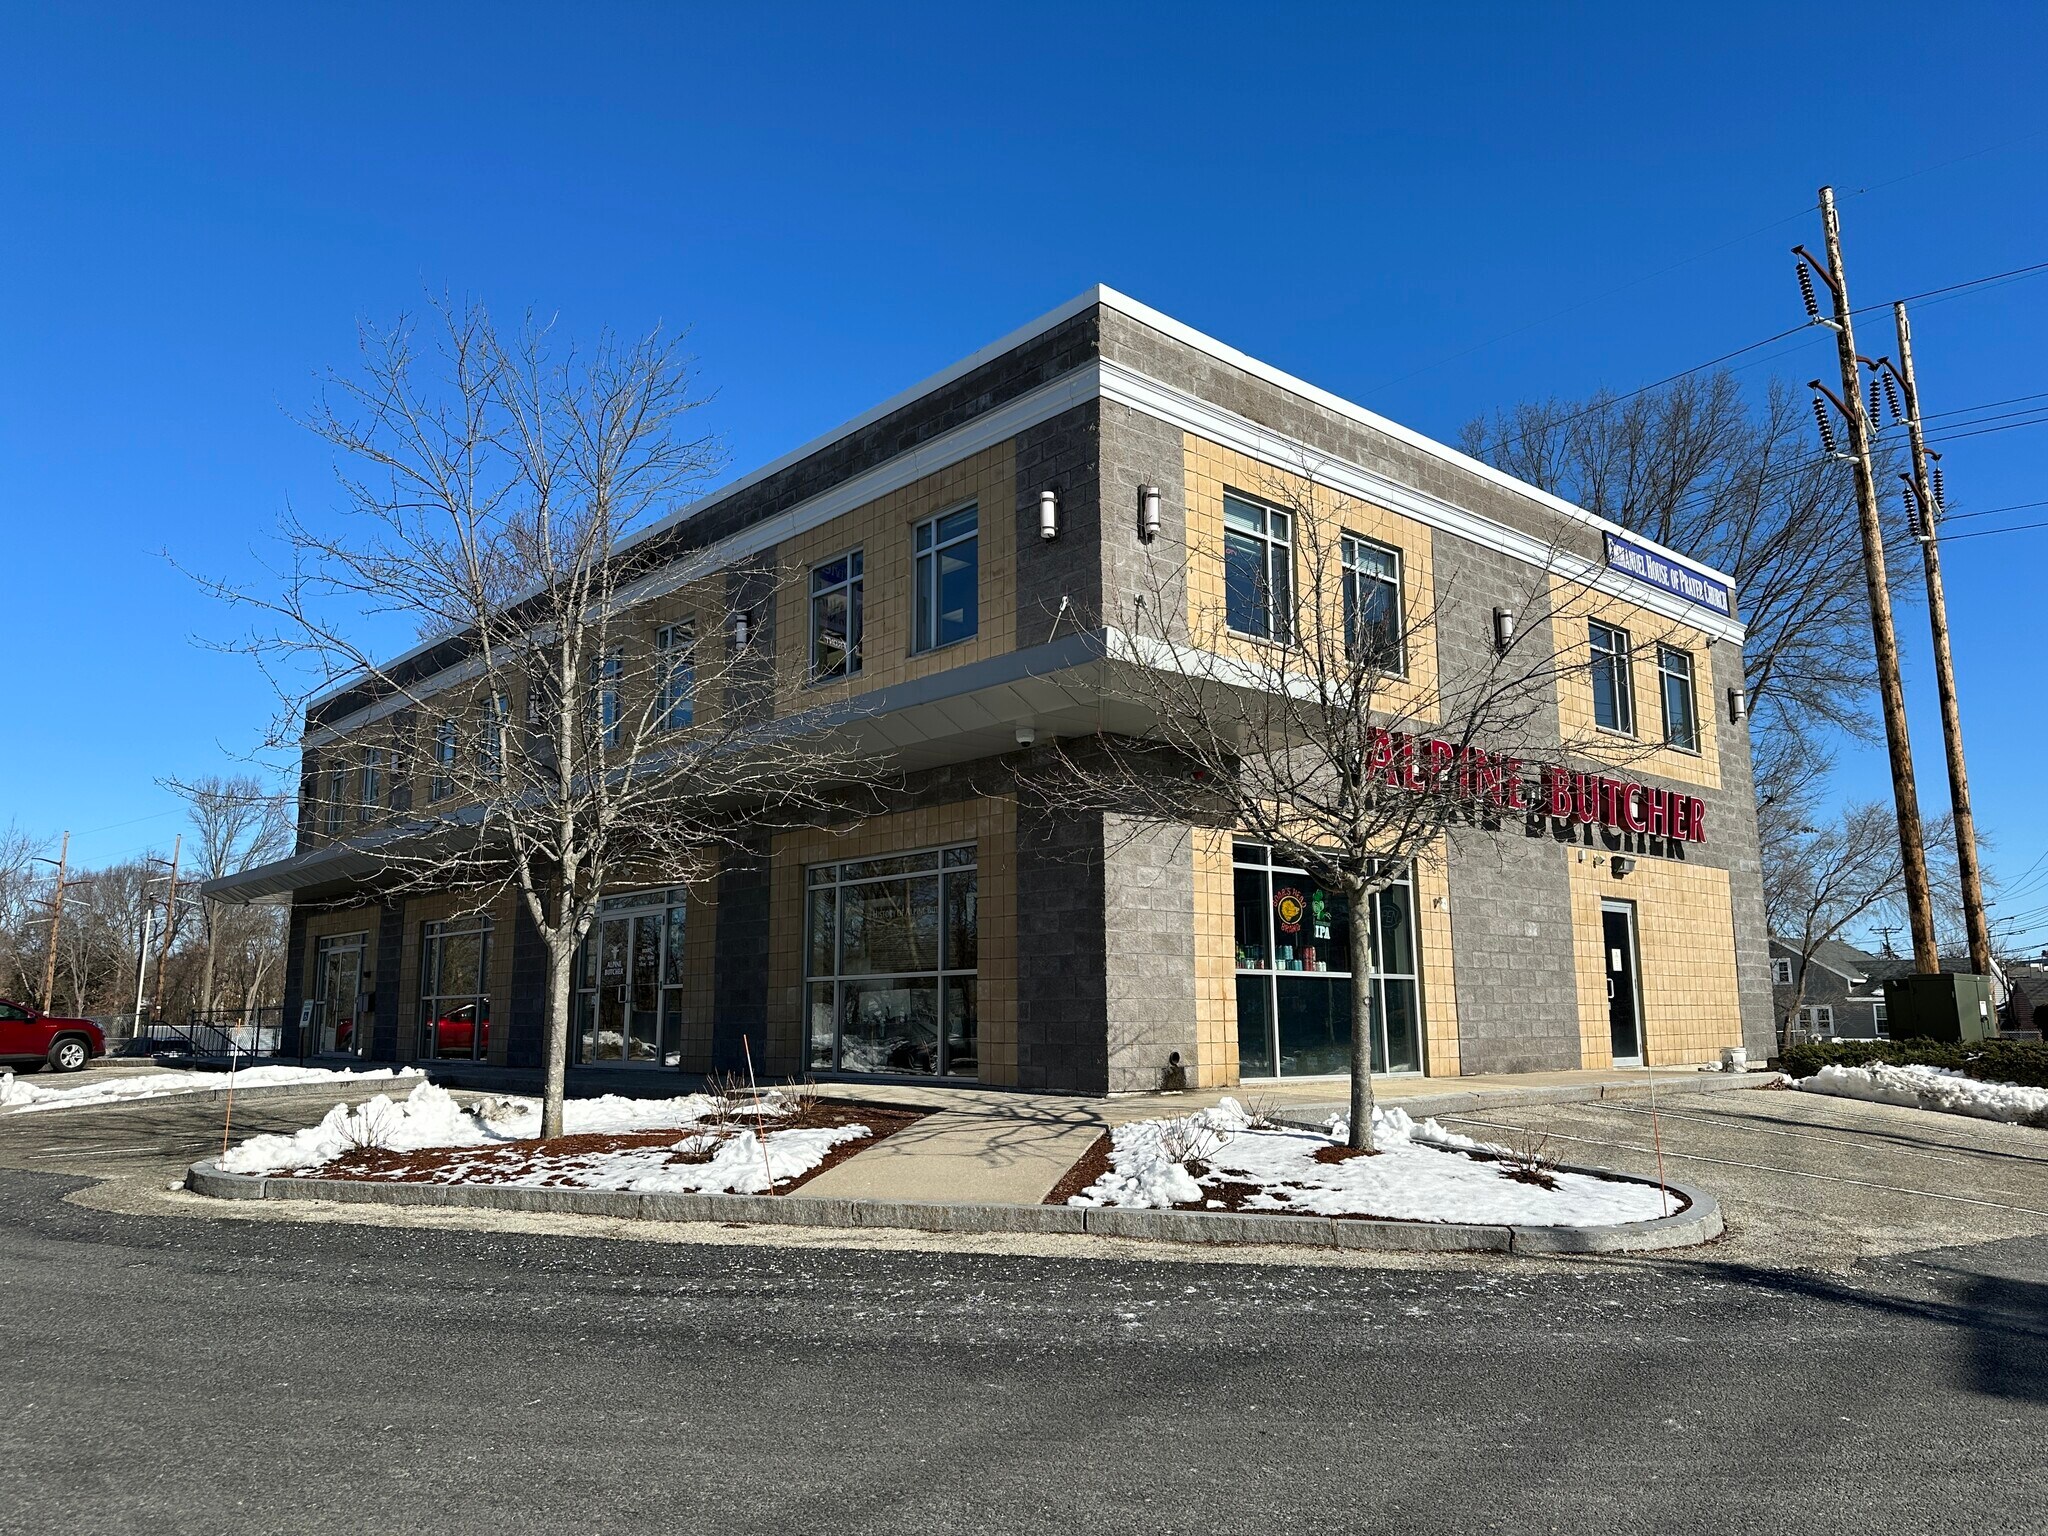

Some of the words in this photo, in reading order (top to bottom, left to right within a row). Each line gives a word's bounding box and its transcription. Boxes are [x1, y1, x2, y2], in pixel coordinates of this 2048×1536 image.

[1646, 555, 1669, 587] HOUSE
[1670, 569, 1680, 591] OF
[1679, 569, 1705, 602] PRAYER
[1704, 580, 1728, 612] CHURCH
[1366, 726, 1527, 810] ALPINE
[1550, 766, 1707, 844] BUTCHER
[1315, 925, 1331, 940] IPA
